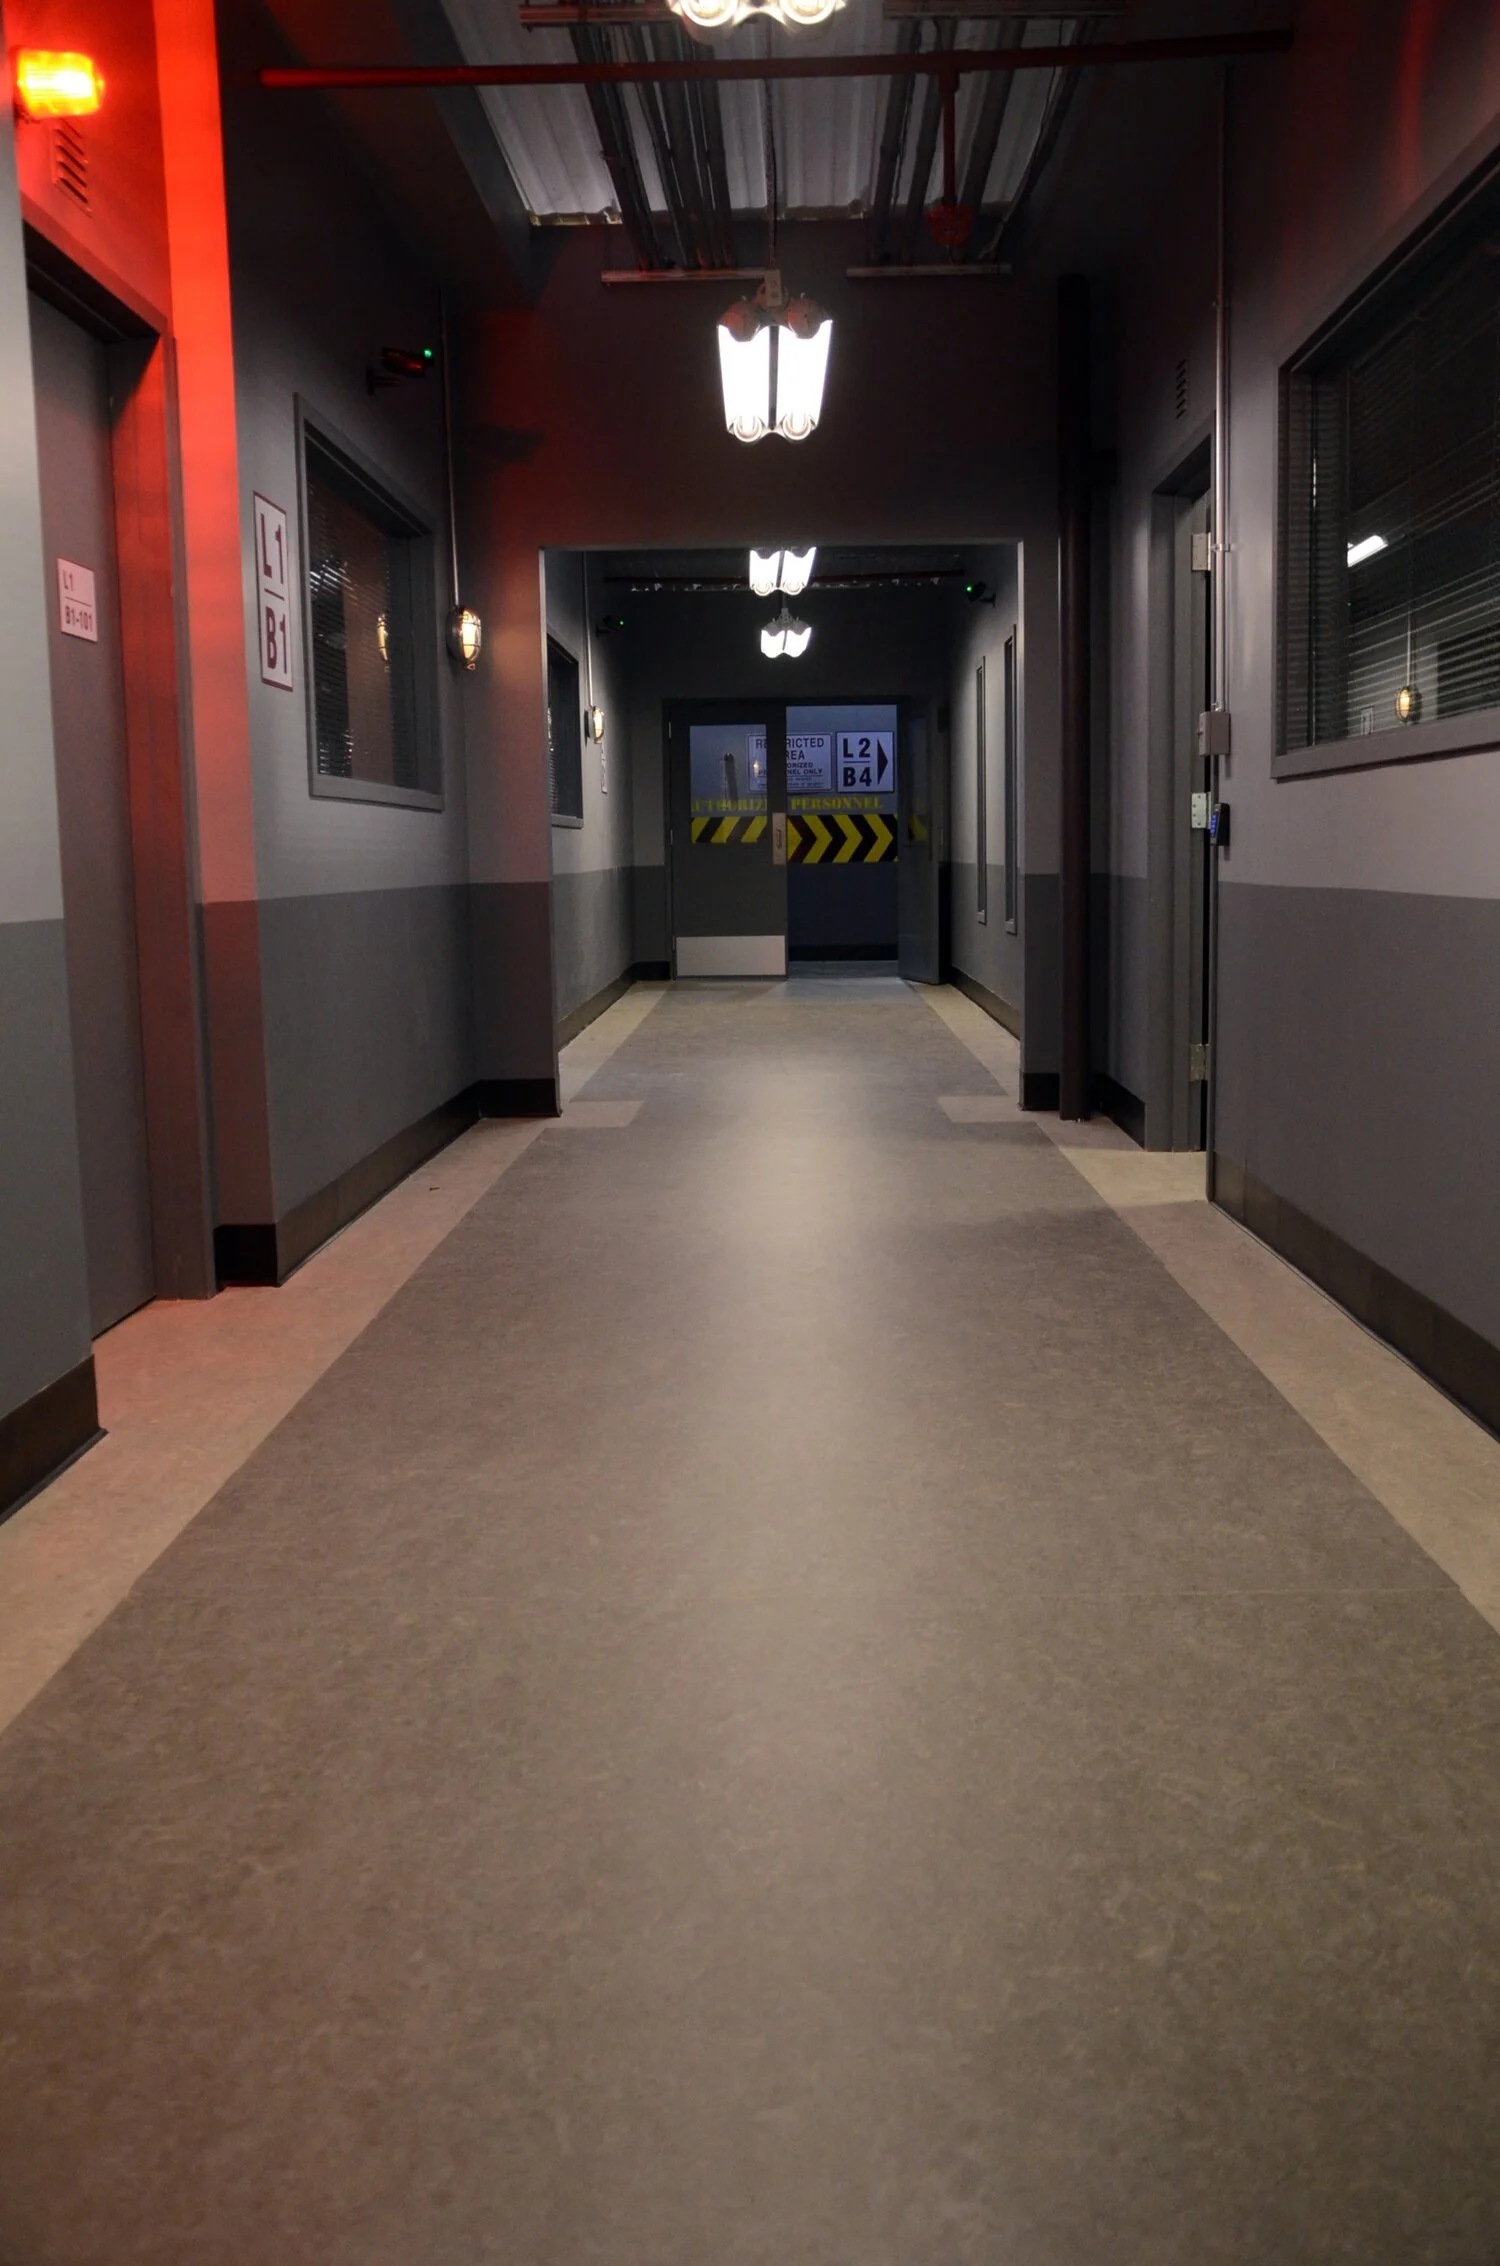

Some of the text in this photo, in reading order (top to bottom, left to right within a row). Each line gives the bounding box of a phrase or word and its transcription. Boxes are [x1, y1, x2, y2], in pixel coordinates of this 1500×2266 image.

[260, 513, 284, 585] L1
[265, 606, 288, 674] B1
[842, 737, 871, 758] L2
[842, 766, 872, 787] B4
